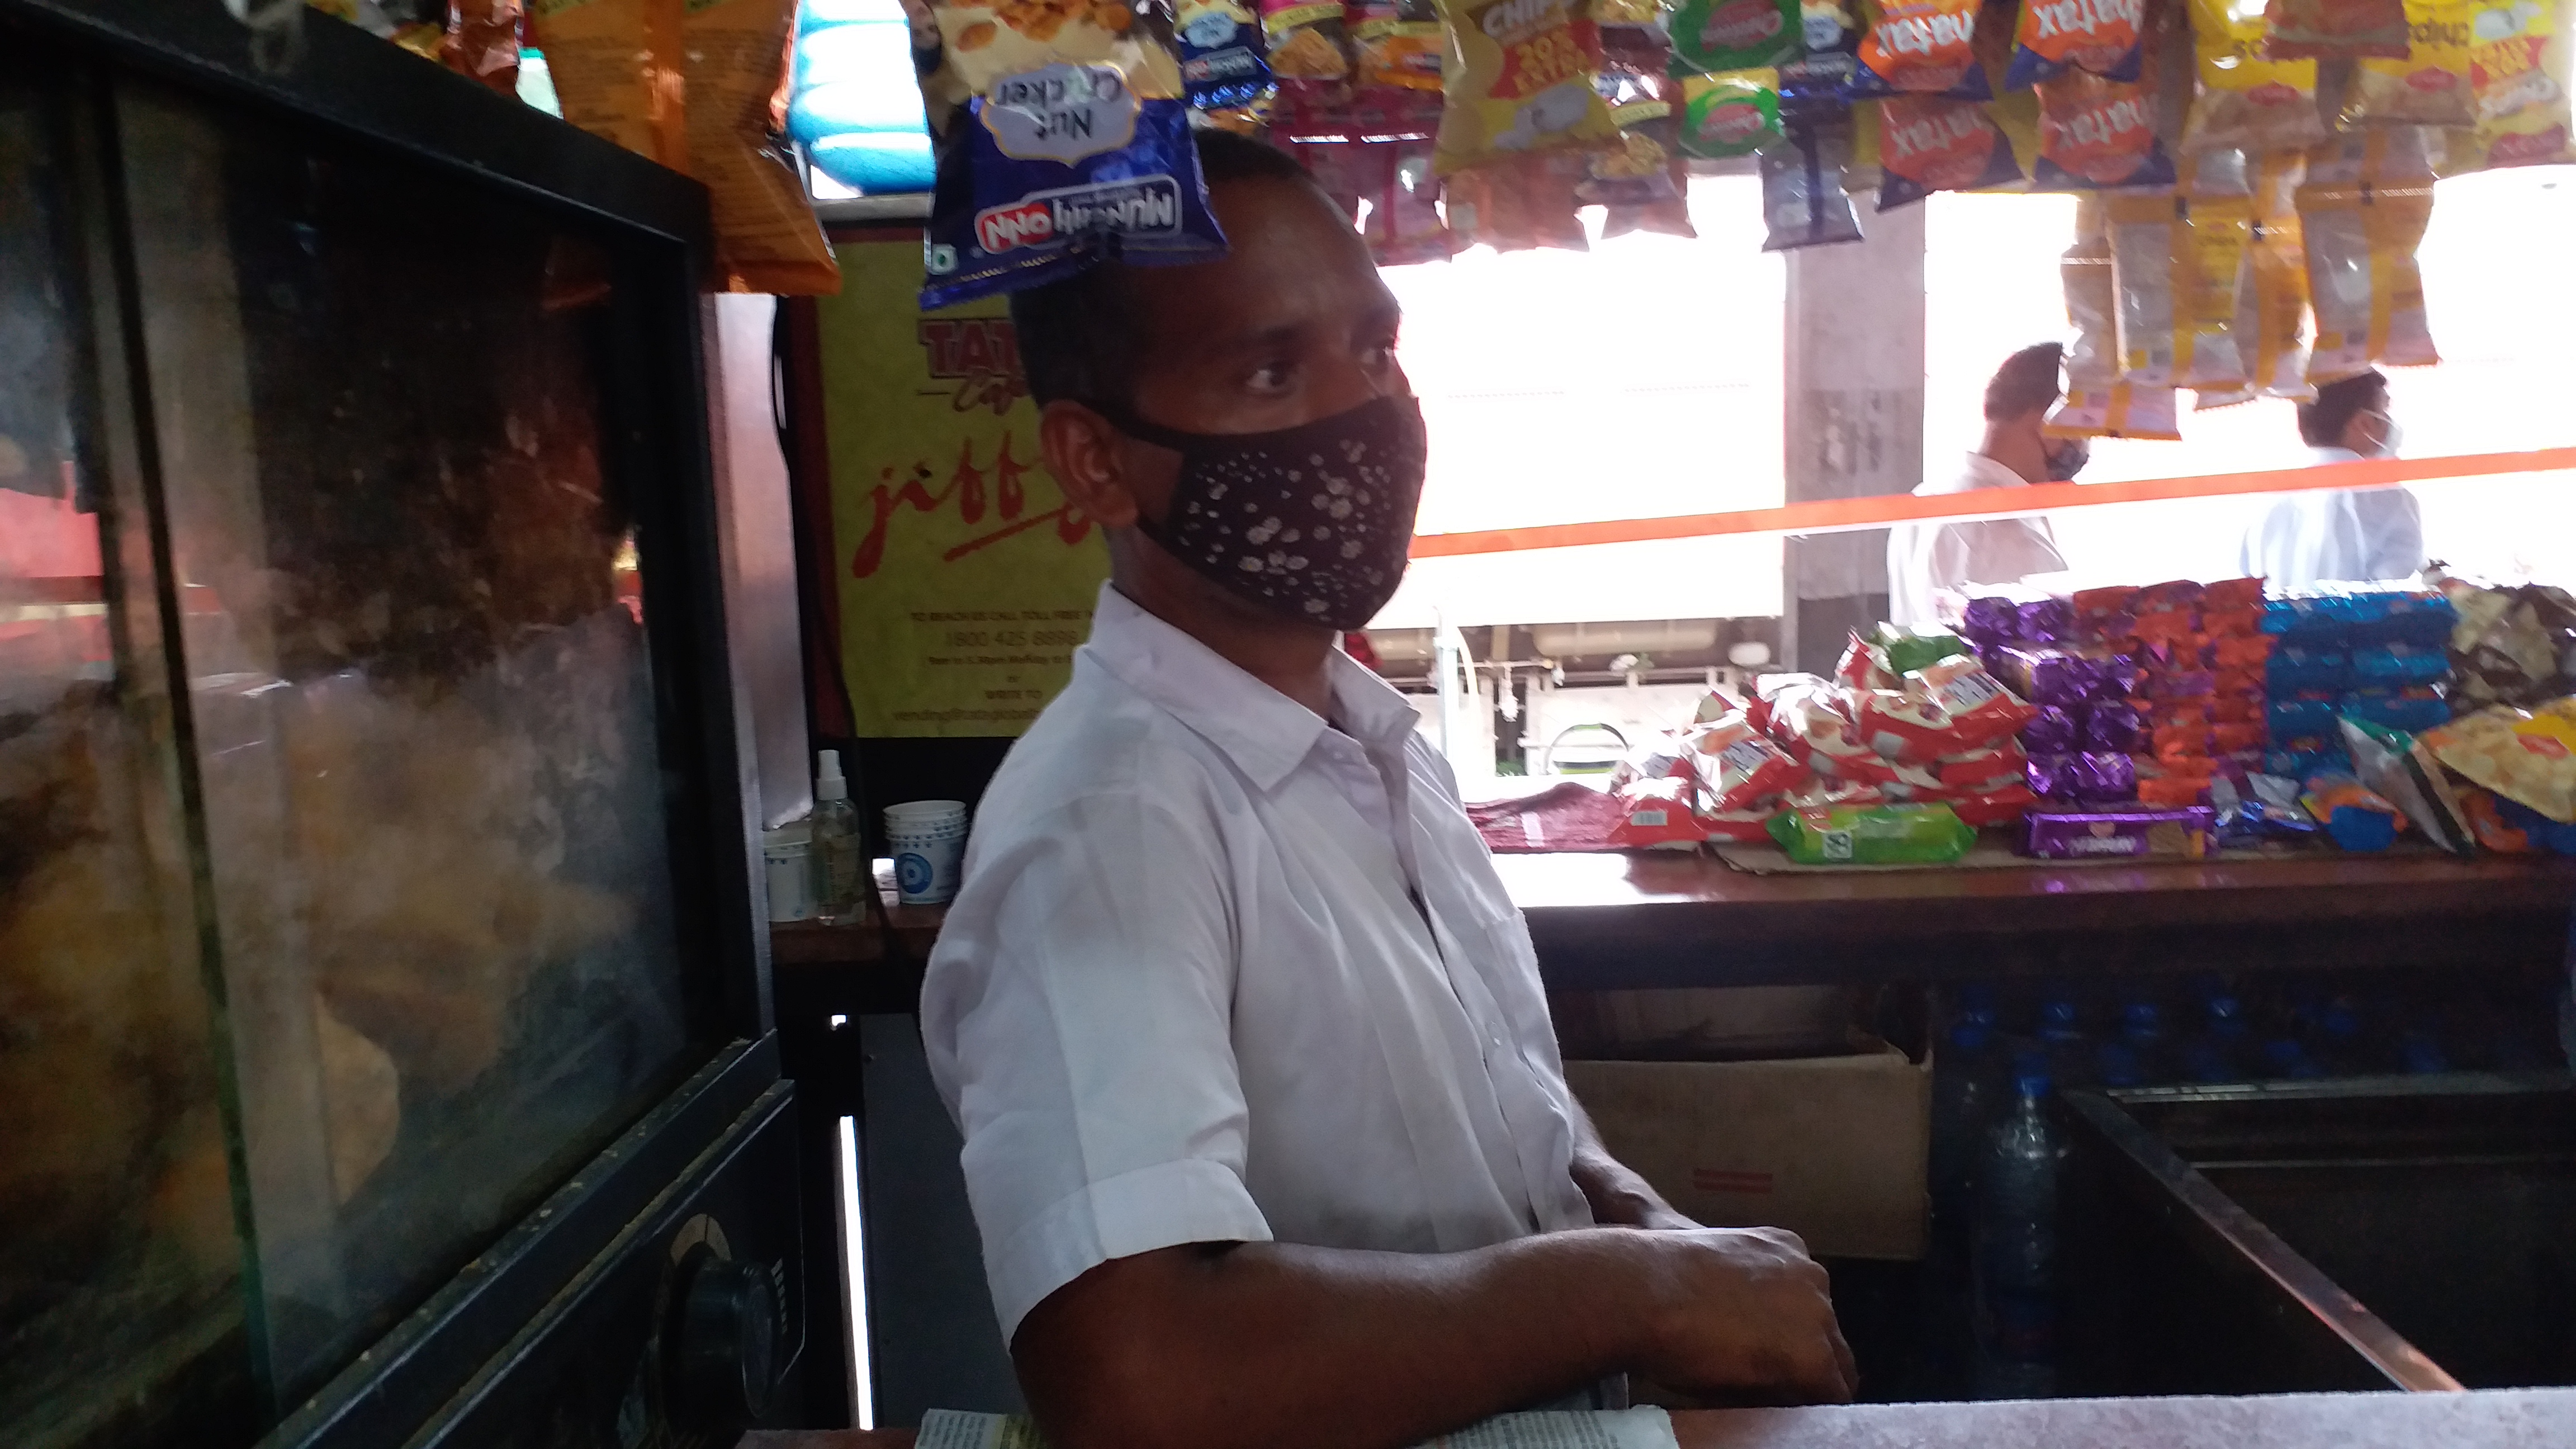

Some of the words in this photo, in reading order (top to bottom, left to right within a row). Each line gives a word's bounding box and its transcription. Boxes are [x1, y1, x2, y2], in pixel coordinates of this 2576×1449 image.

[2407, 17, 2469, 51] chip
[996, 72, 1120, 106] Crcker
[919, 318, 1025, 378] TAT
